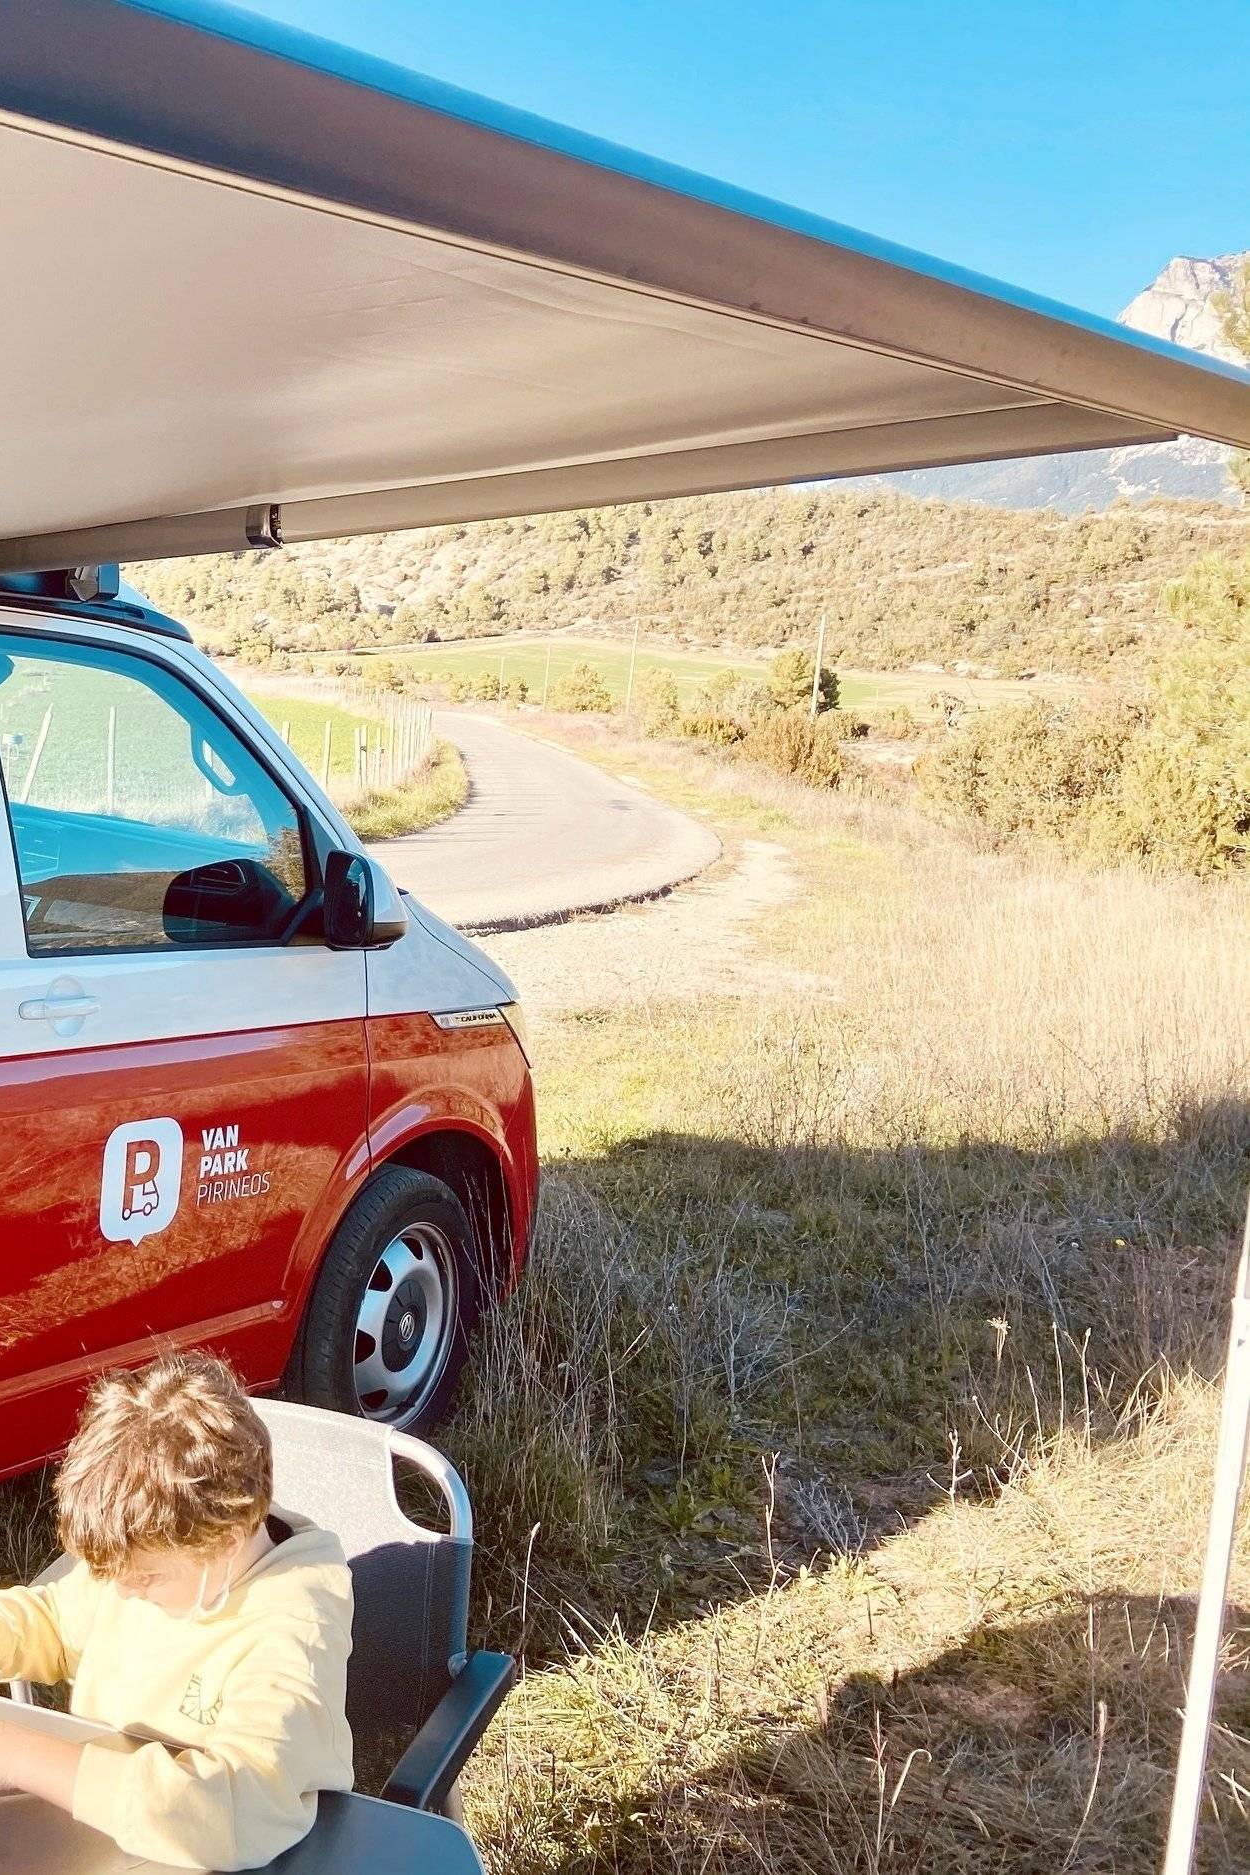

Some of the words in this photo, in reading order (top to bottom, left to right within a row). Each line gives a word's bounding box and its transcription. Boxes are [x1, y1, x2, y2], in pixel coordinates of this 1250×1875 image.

[201, 1125, 239, 1151] VAN
[200, 1149, 249, 1178] PARK
[197, 1172, 271, 1205] PIRINEOS
